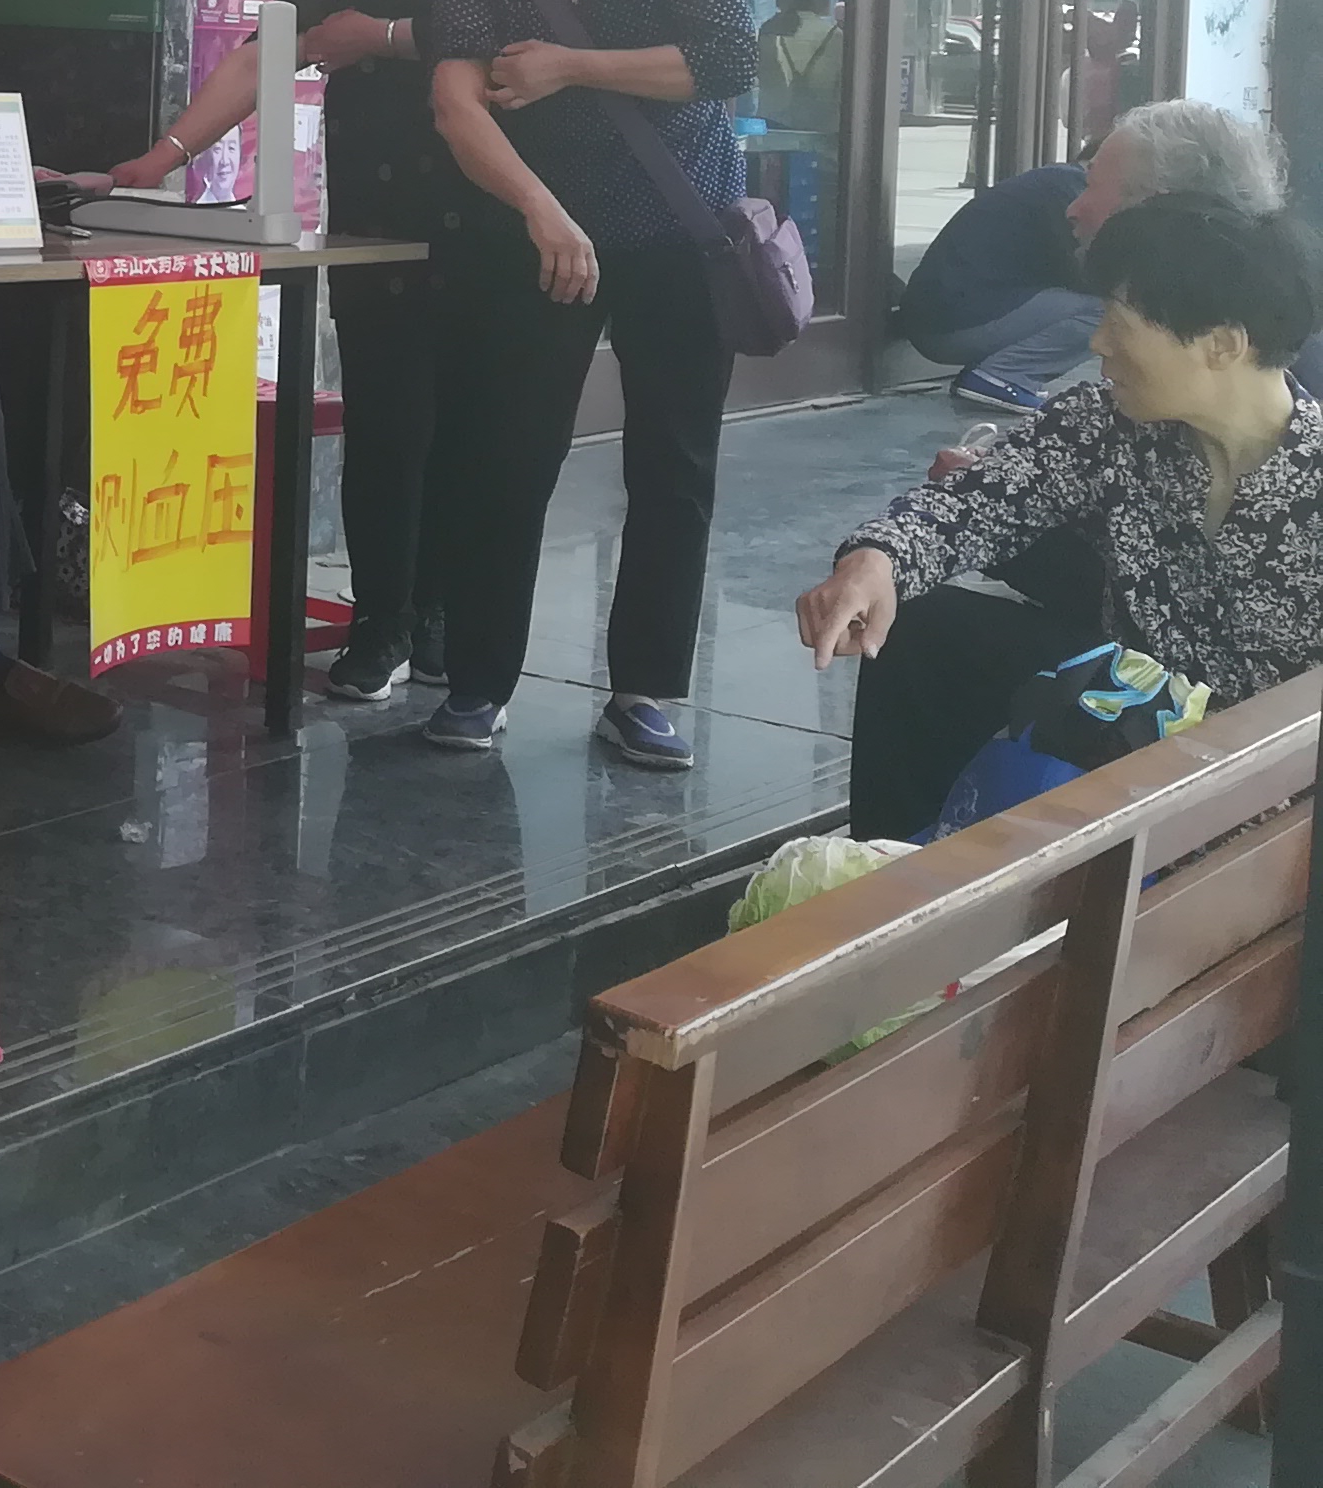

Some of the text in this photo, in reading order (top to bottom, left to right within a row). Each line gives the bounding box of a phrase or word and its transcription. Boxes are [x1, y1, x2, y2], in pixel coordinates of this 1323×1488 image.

[112, 282, 224, 420] 免费
[93, 448, 255, 573] 测血压
[93, 622, 233, 666] 一切为了您的健康
